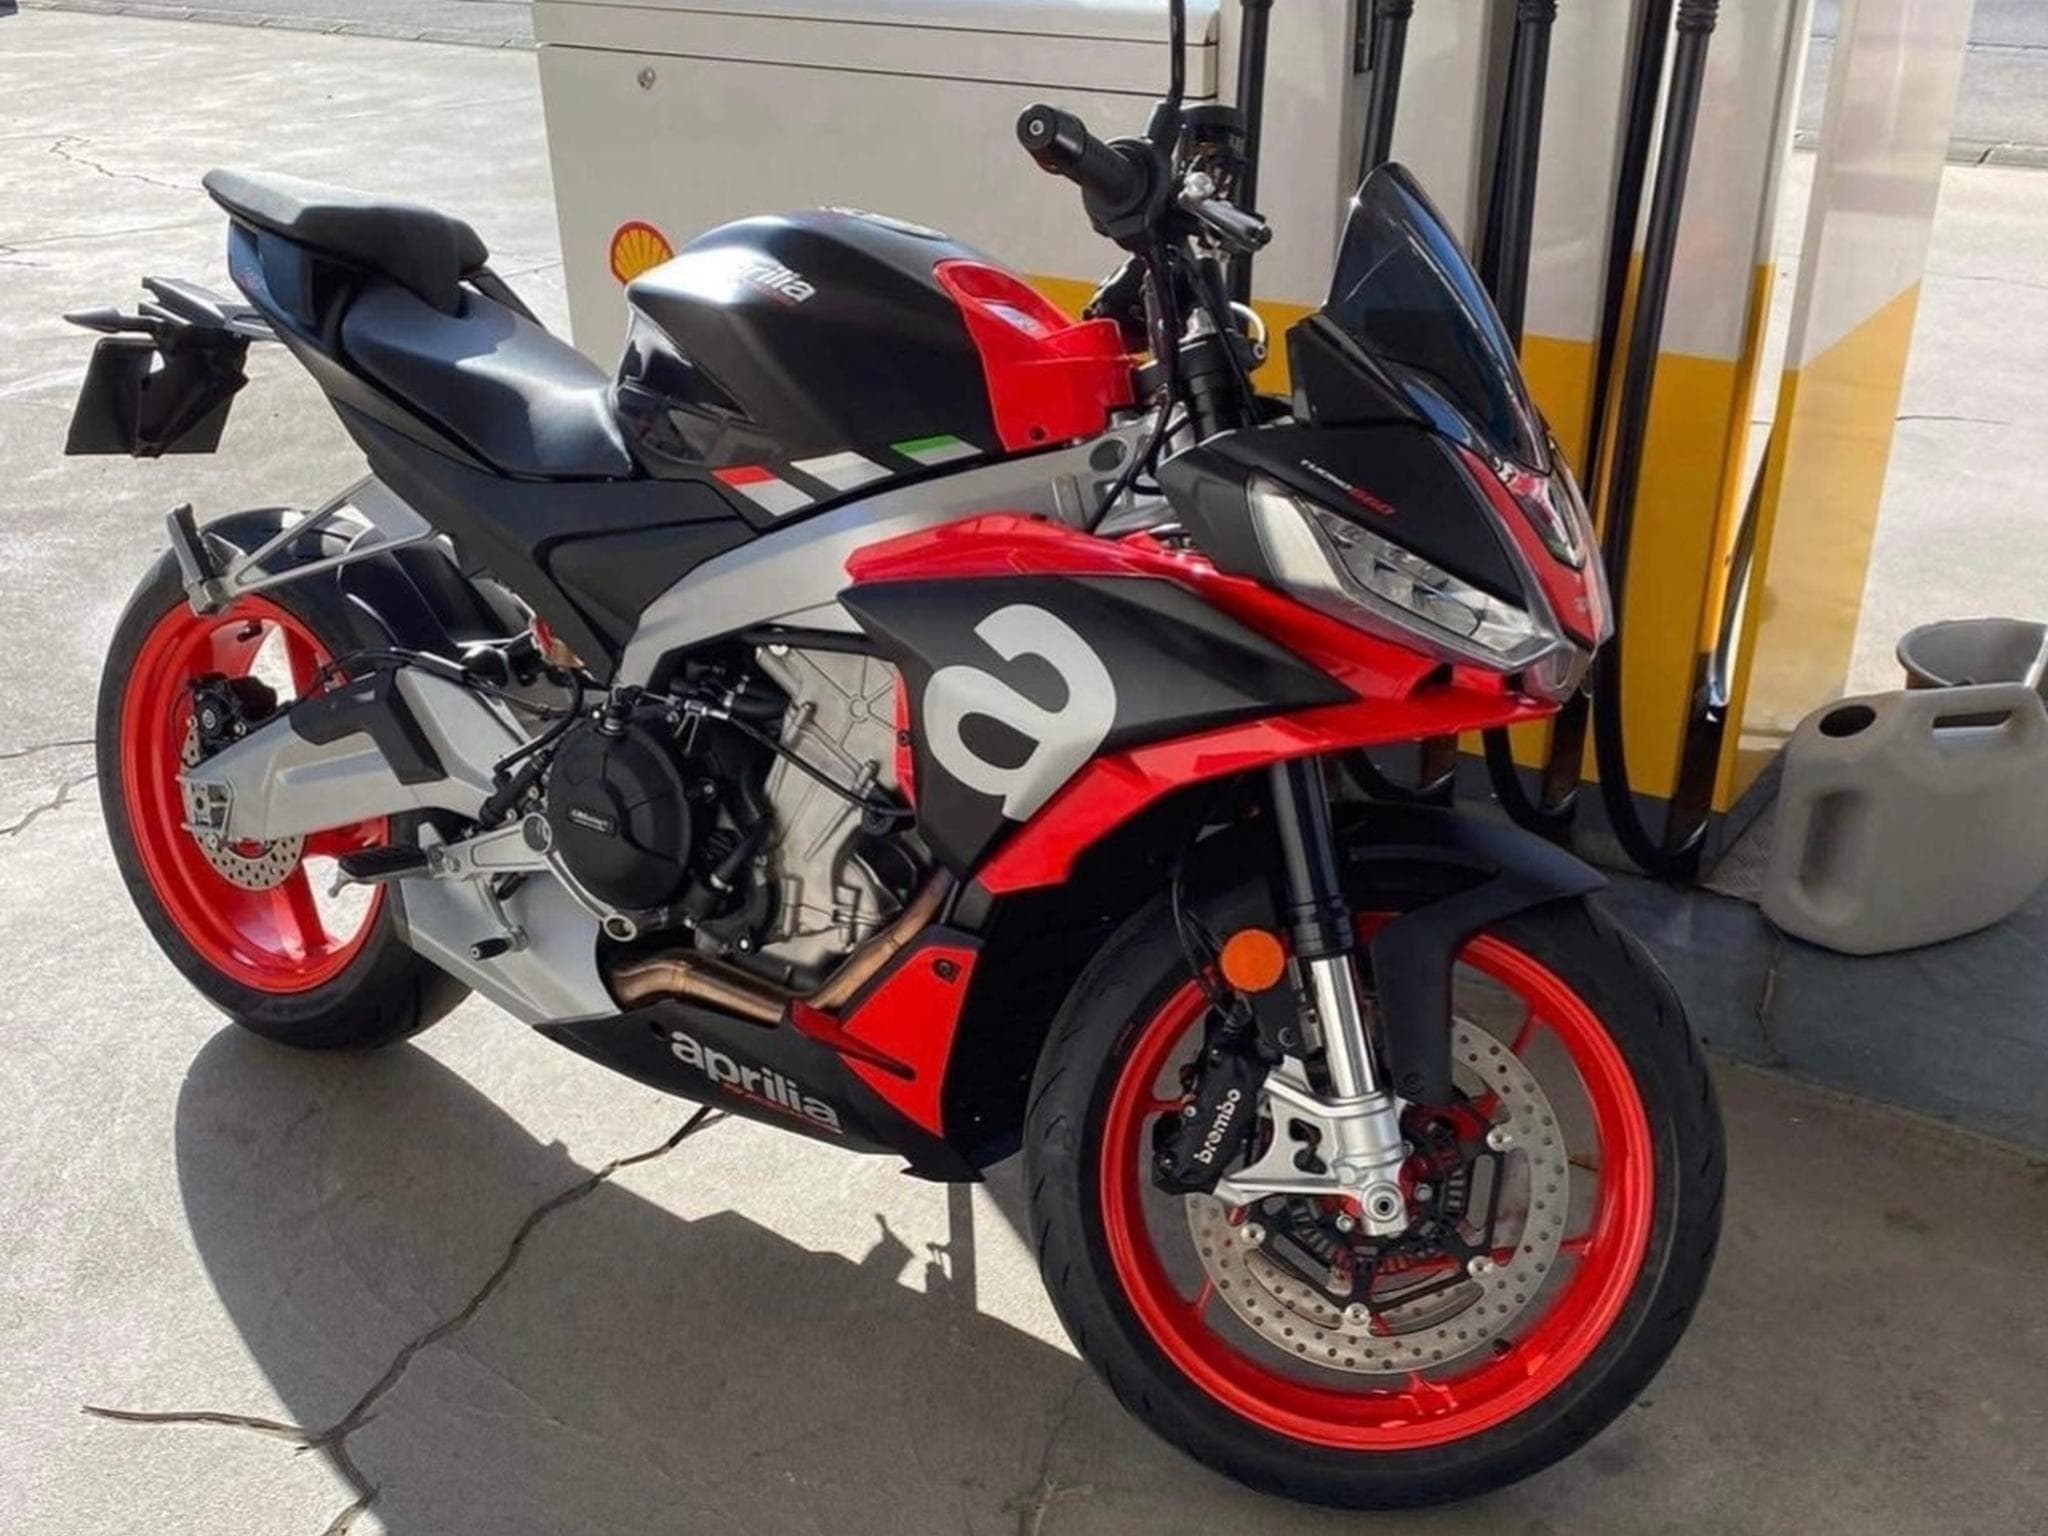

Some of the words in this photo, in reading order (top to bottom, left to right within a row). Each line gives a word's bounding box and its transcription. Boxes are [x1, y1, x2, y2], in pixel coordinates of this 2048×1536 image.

[923, 603, 1117, 822] a
[671, 1031, 841, 1129] aprilia
[1193, 1088, 1241, 1165] brembo
